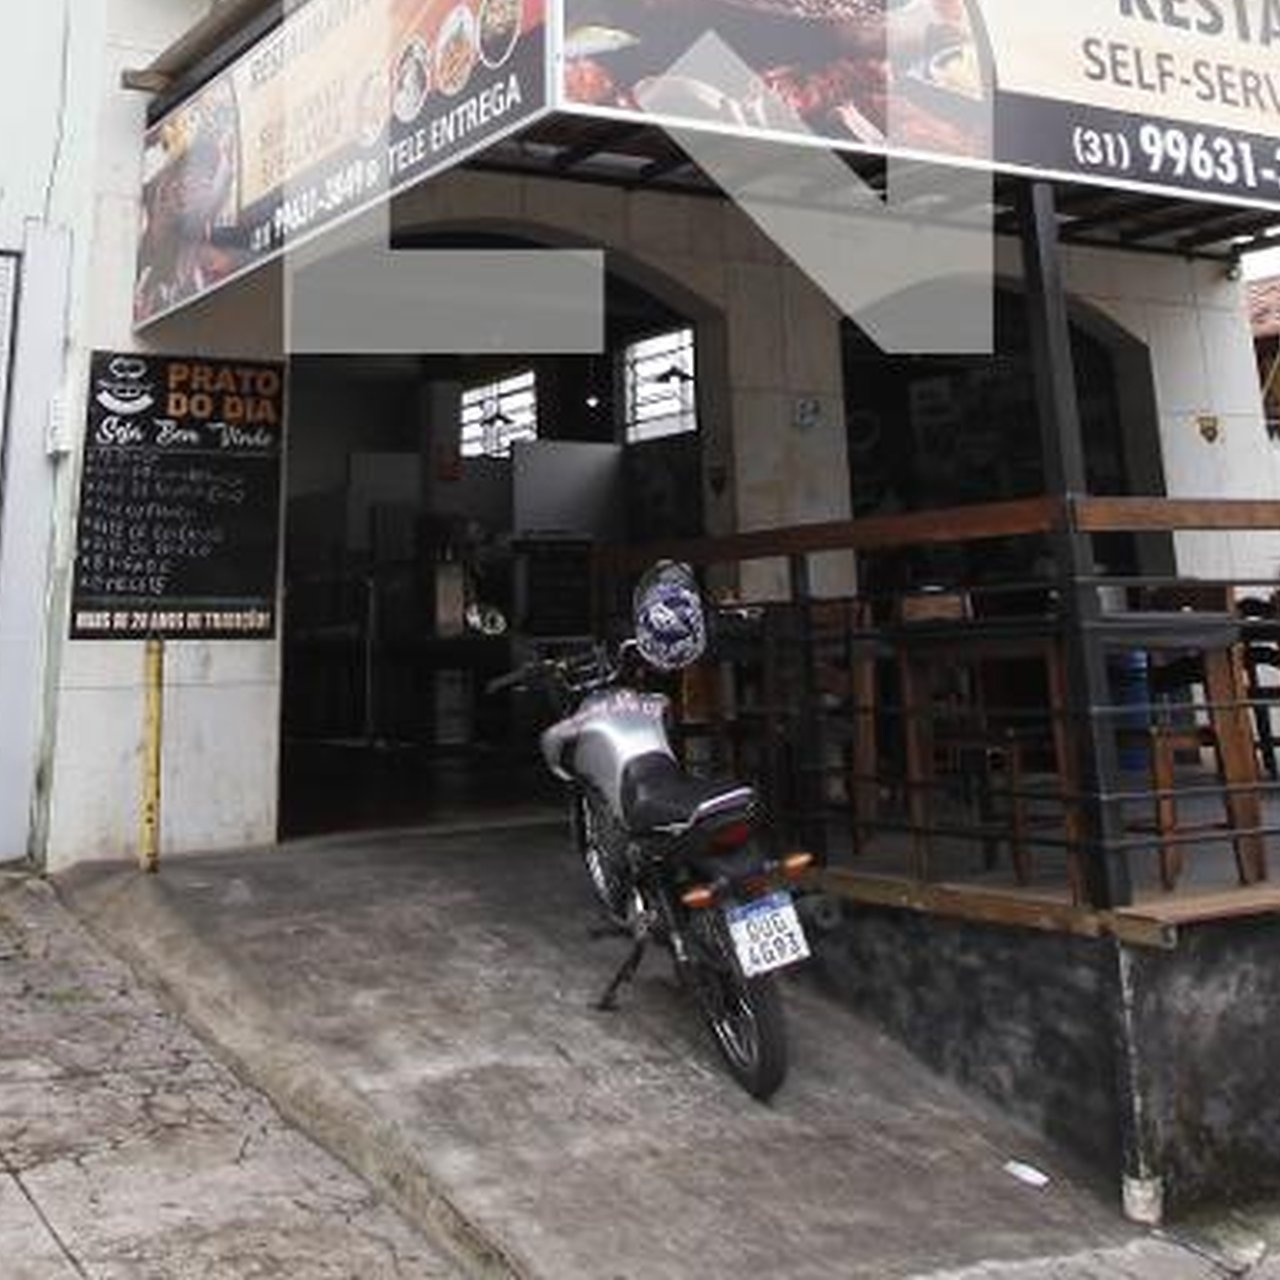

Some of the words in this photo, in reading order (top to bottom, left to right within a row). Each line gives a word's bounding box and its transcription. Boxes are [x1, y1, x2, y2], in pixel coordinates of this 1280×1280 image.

[387, 130, 426, 178] TELE
[430, 73, 521, 151] ENTREGA
[1072, 126, 1130, 170] (31)
[168, 363, 279, 396] PRATO
[167, 392, 213, 418] DO
[223, 395, 276, 423] DIA
